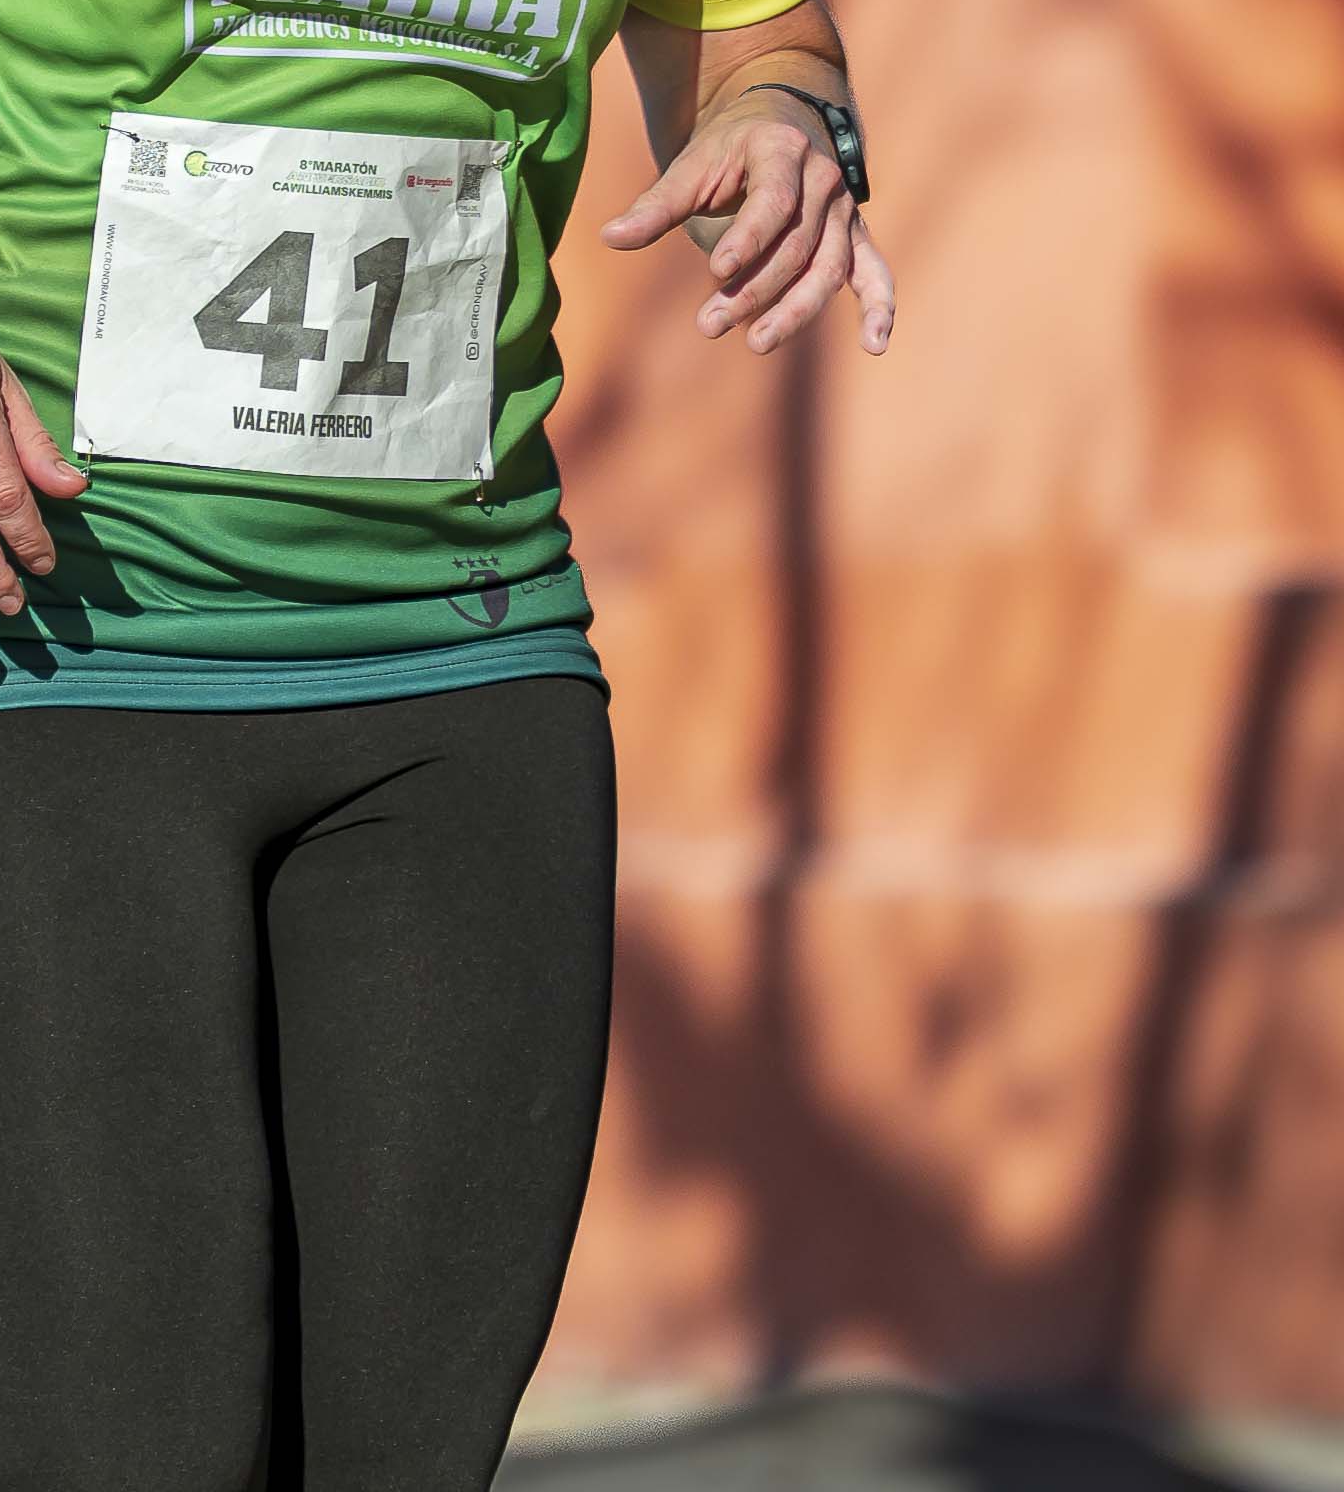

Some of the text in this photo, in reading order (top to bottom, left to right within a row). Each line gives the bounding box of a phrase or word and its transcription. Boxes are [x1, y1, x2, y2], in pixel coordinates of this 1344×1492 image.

[272, 181, 393, 200] CAWILLIAMSKEMMIS
[193, 231, 409, 397] 41
[471, 263, 488, 339] @CRONORAV
[233, 406, 373, 439] VALERIA FERRERO
